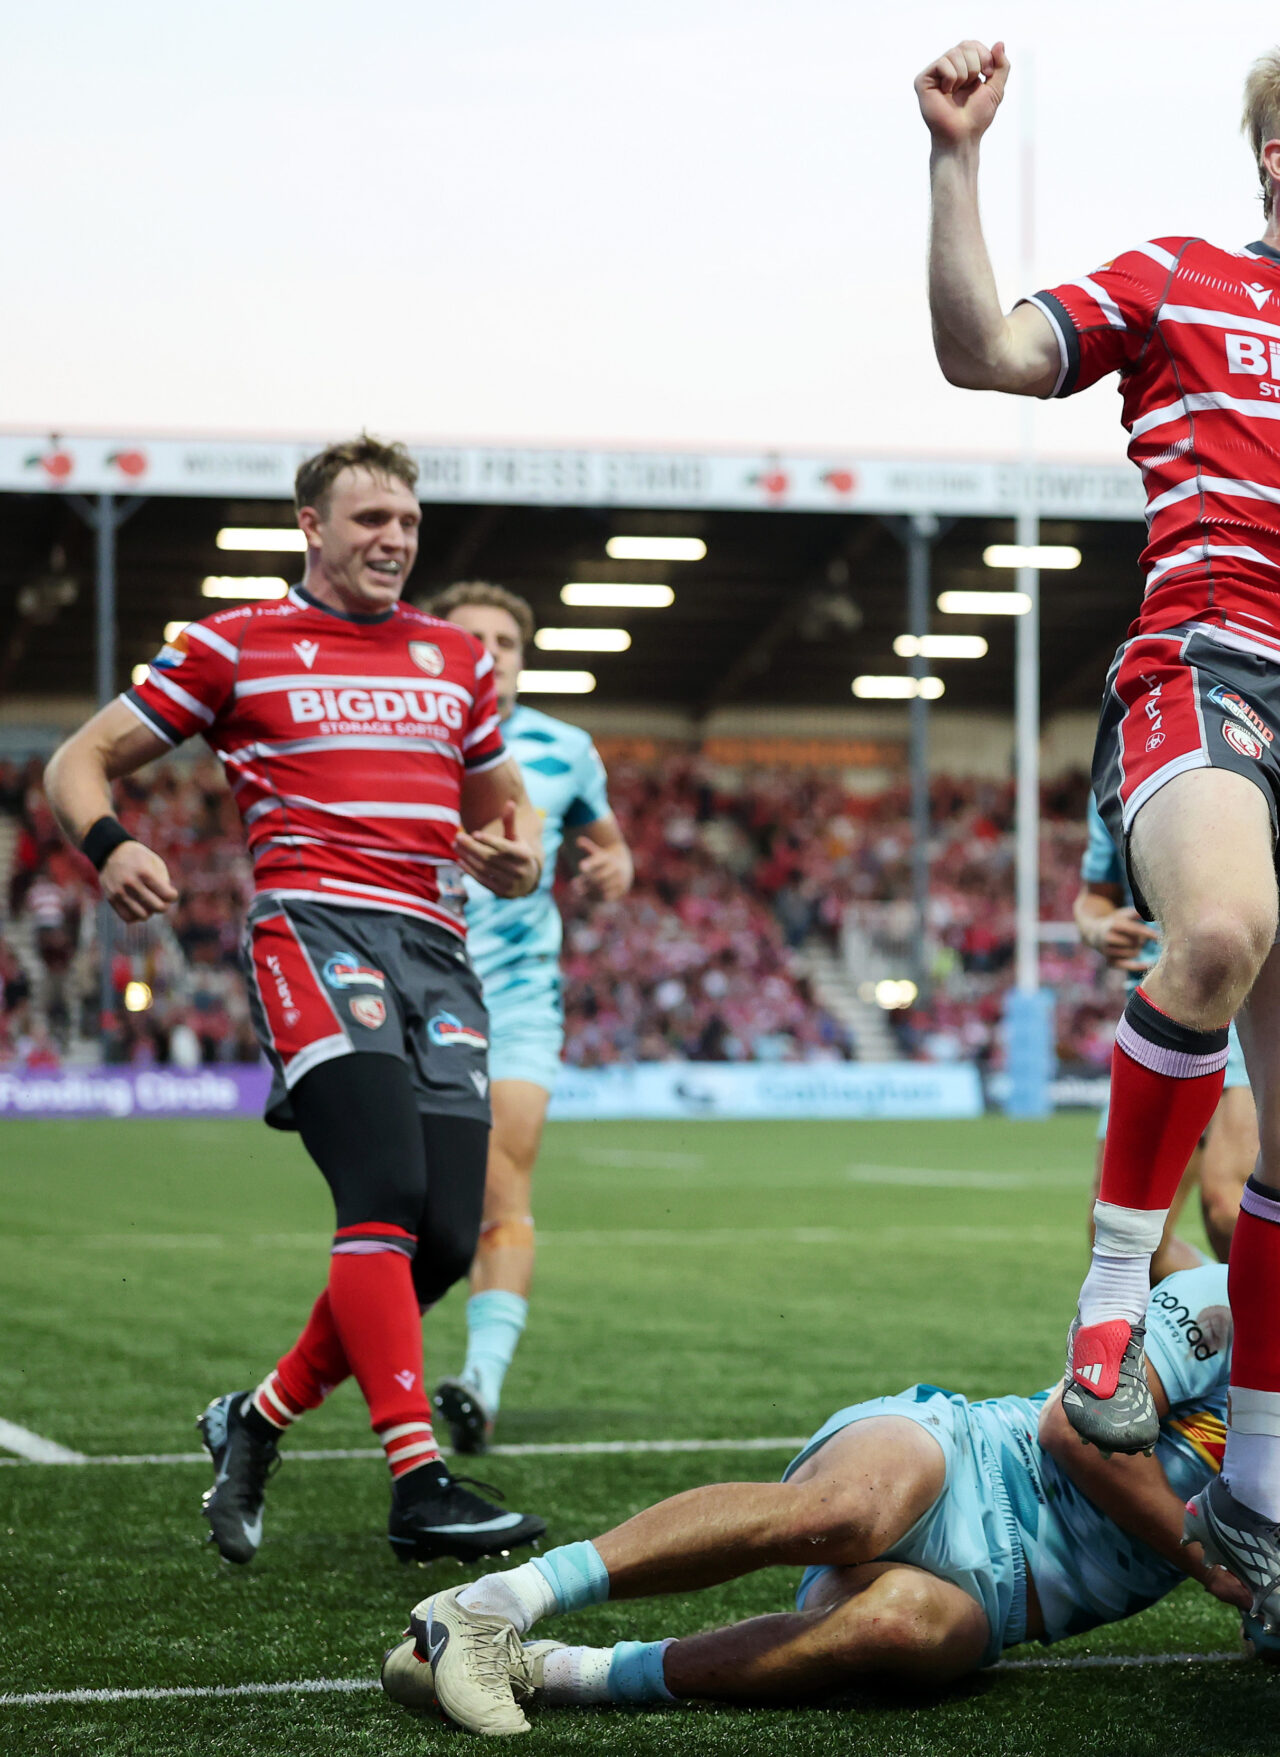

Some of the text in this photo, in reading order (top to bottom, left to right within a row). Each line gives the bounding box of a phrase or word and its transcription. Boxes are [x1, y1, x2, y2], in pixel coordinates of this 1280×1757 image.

[319, 721, 450, 740] STORAGE SORTED
[1152, 1291, 1218, 1362] conrad
